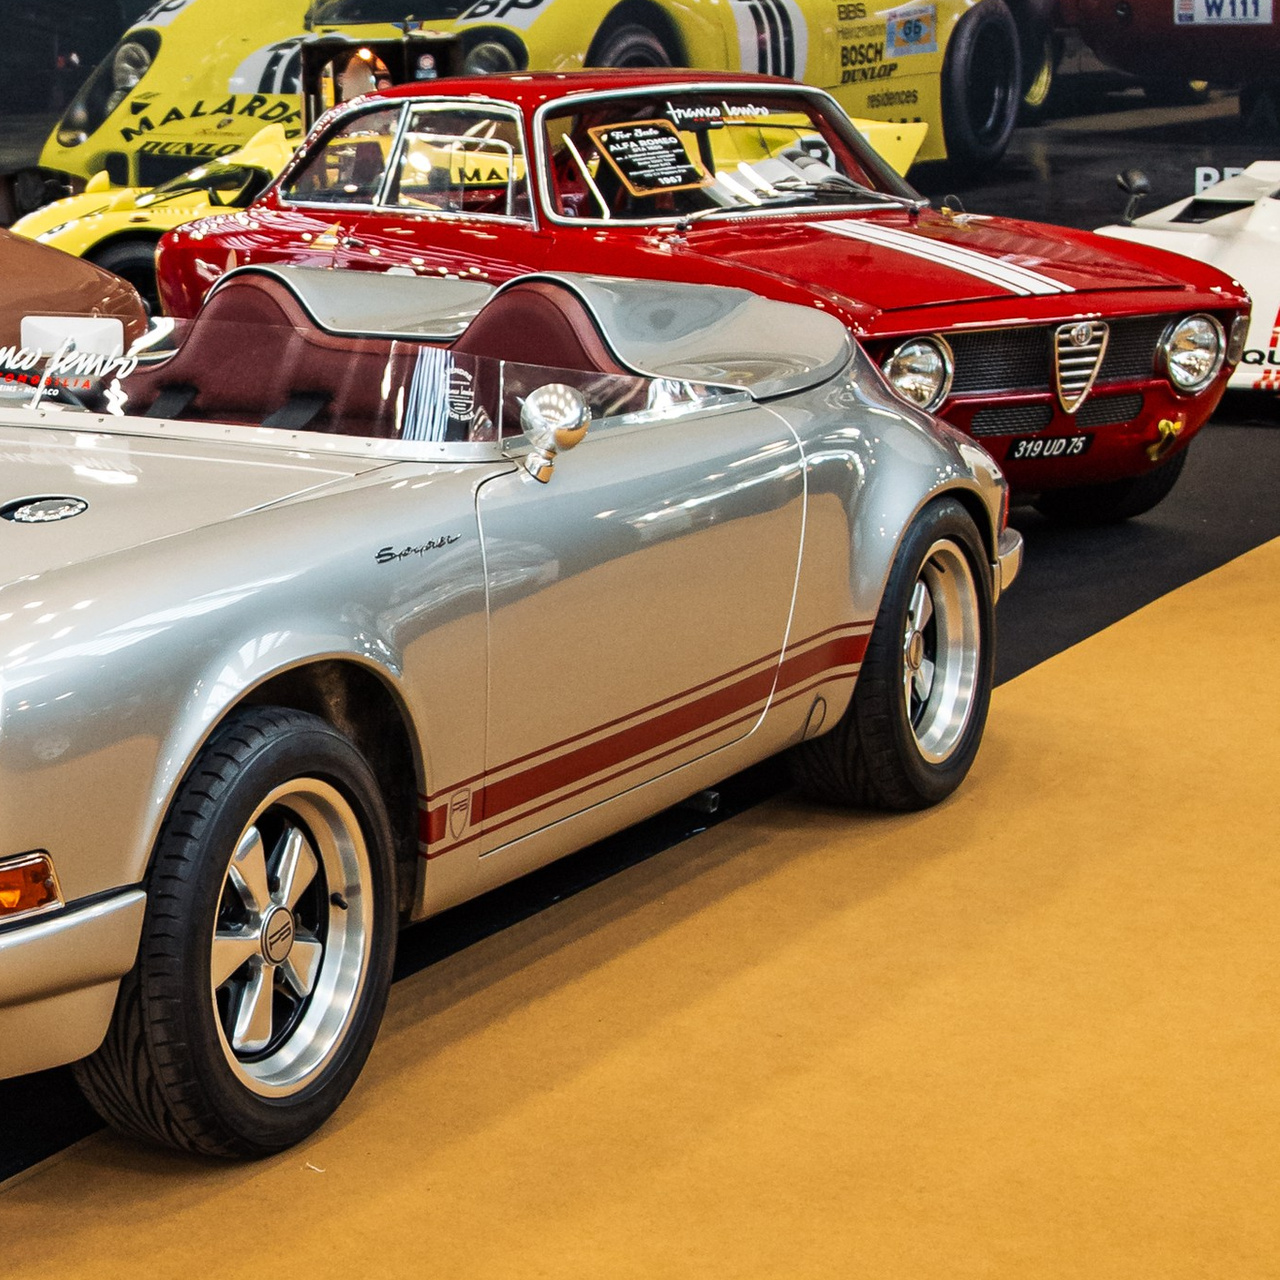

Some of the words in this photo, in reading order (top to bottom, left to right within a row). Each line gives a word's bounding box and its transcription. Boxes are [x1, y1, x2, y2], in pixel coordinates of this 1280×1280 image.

[837, 3, 867, 21] BBS
[840, 42, 884, 67] BOSCH
[840, 62, 898, 83] DUNLOP
[609, 140, 638, 152] ALFA
[638, 136, 678, 147] ROMEO
[1014, 440, 1044, 458] 319
[1043, 439, 1067, 456] UD
[1066, 436, 1087, 454] 75
